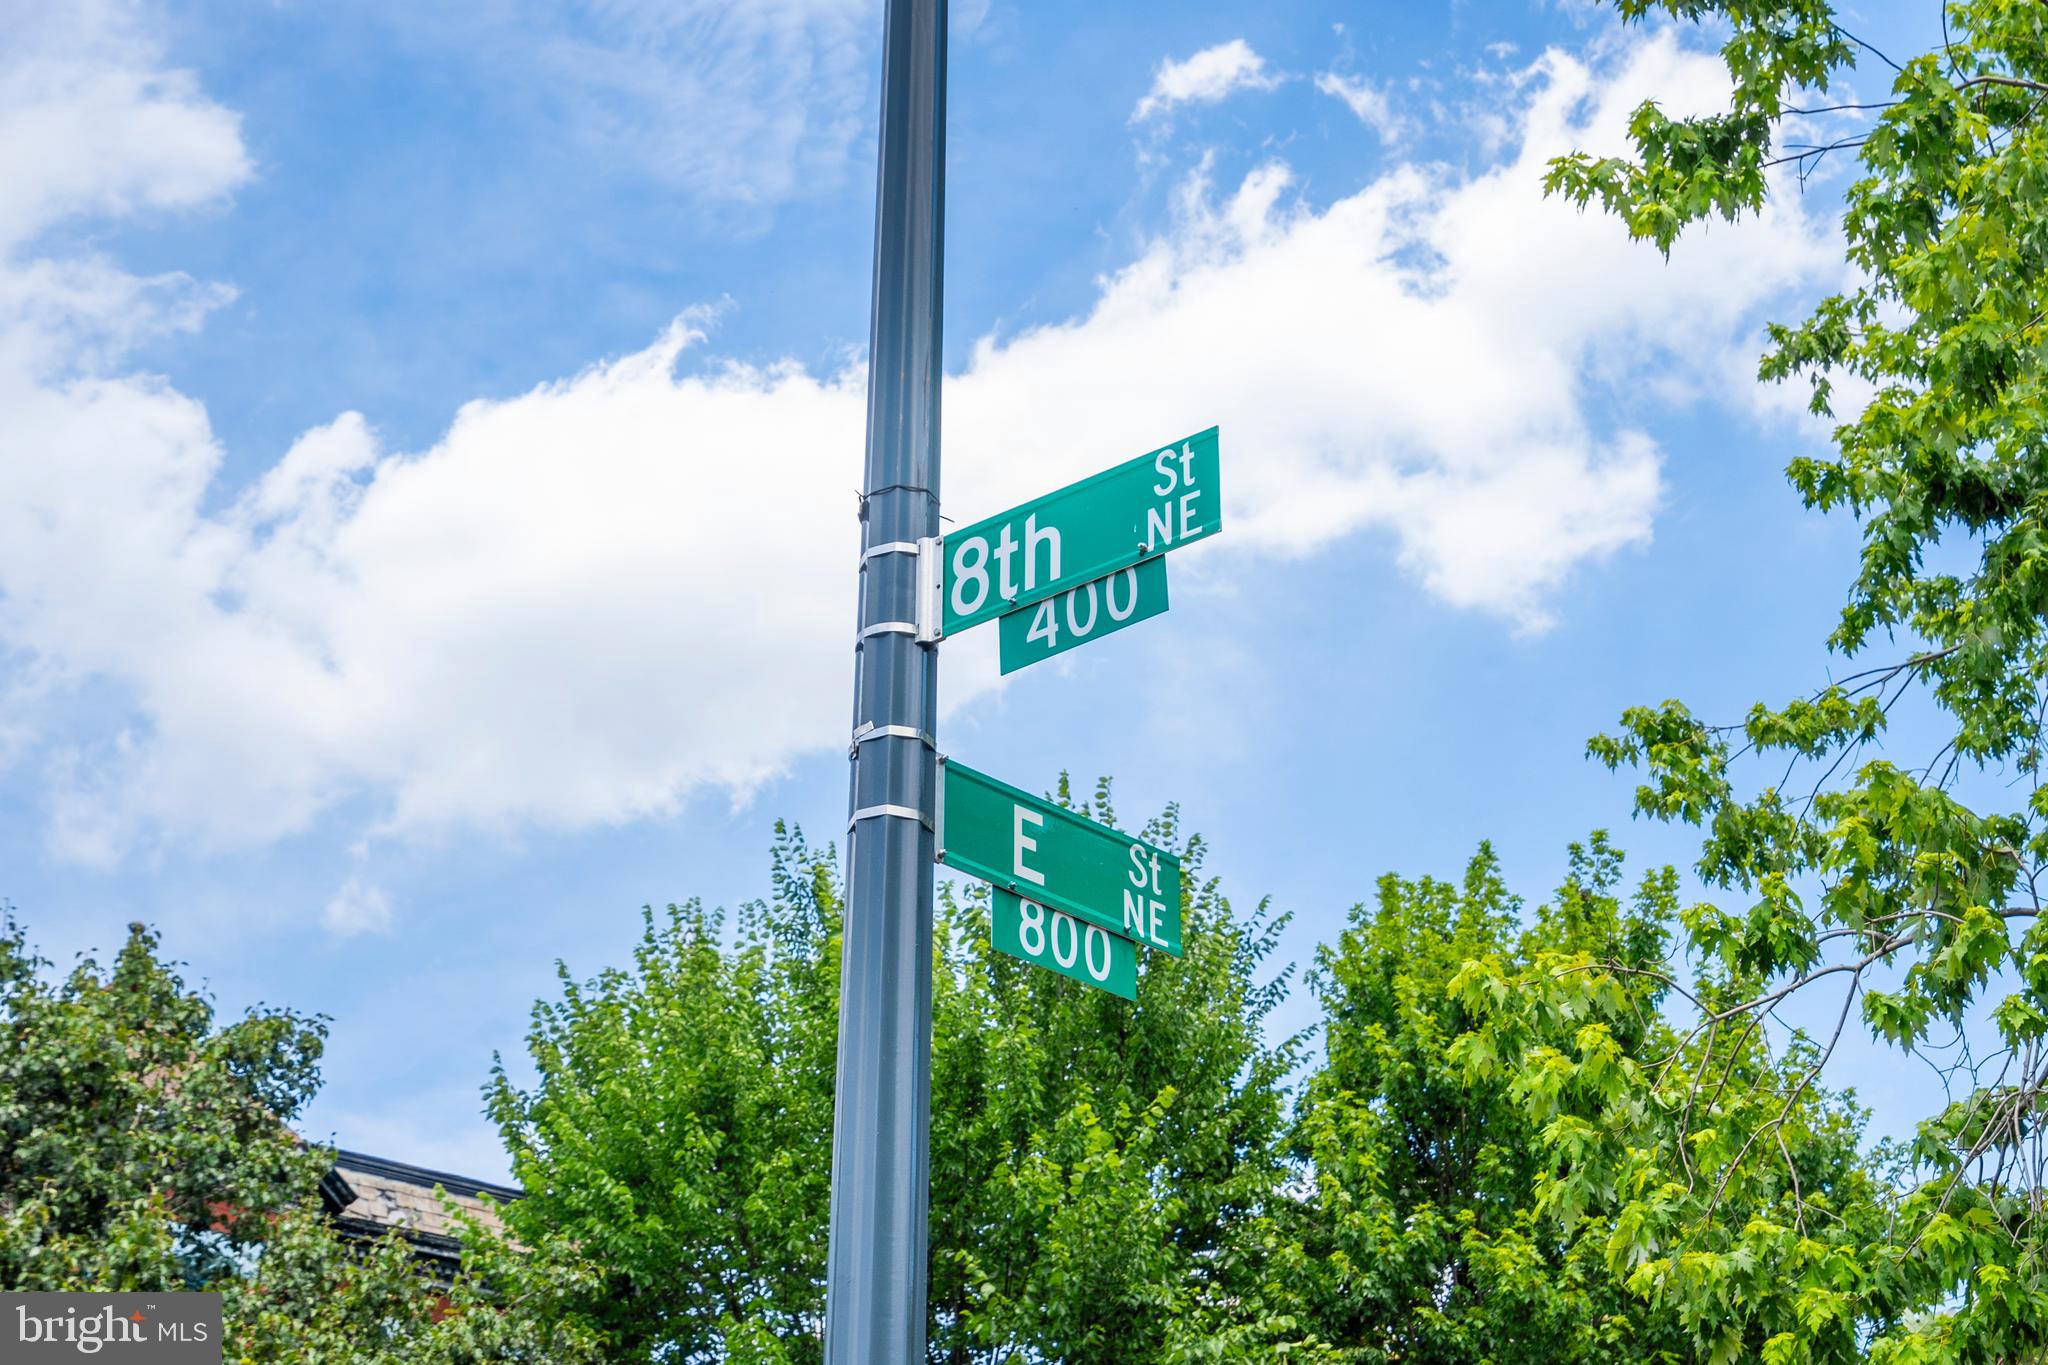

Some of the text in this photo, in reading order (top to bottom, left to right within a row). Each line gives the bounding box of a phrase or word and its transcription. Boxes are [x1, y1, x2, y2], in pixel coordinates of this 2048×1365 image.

[951, 441, 1196, 616] 8th St
[1147, 489, 1203, 553] NE
[1026, 567, 1138, 649] 400
[1013, 803, 1162, 896] E St
[1019, 897, 1112, 982] 800
[1123, 888, 1169, 948] NE
